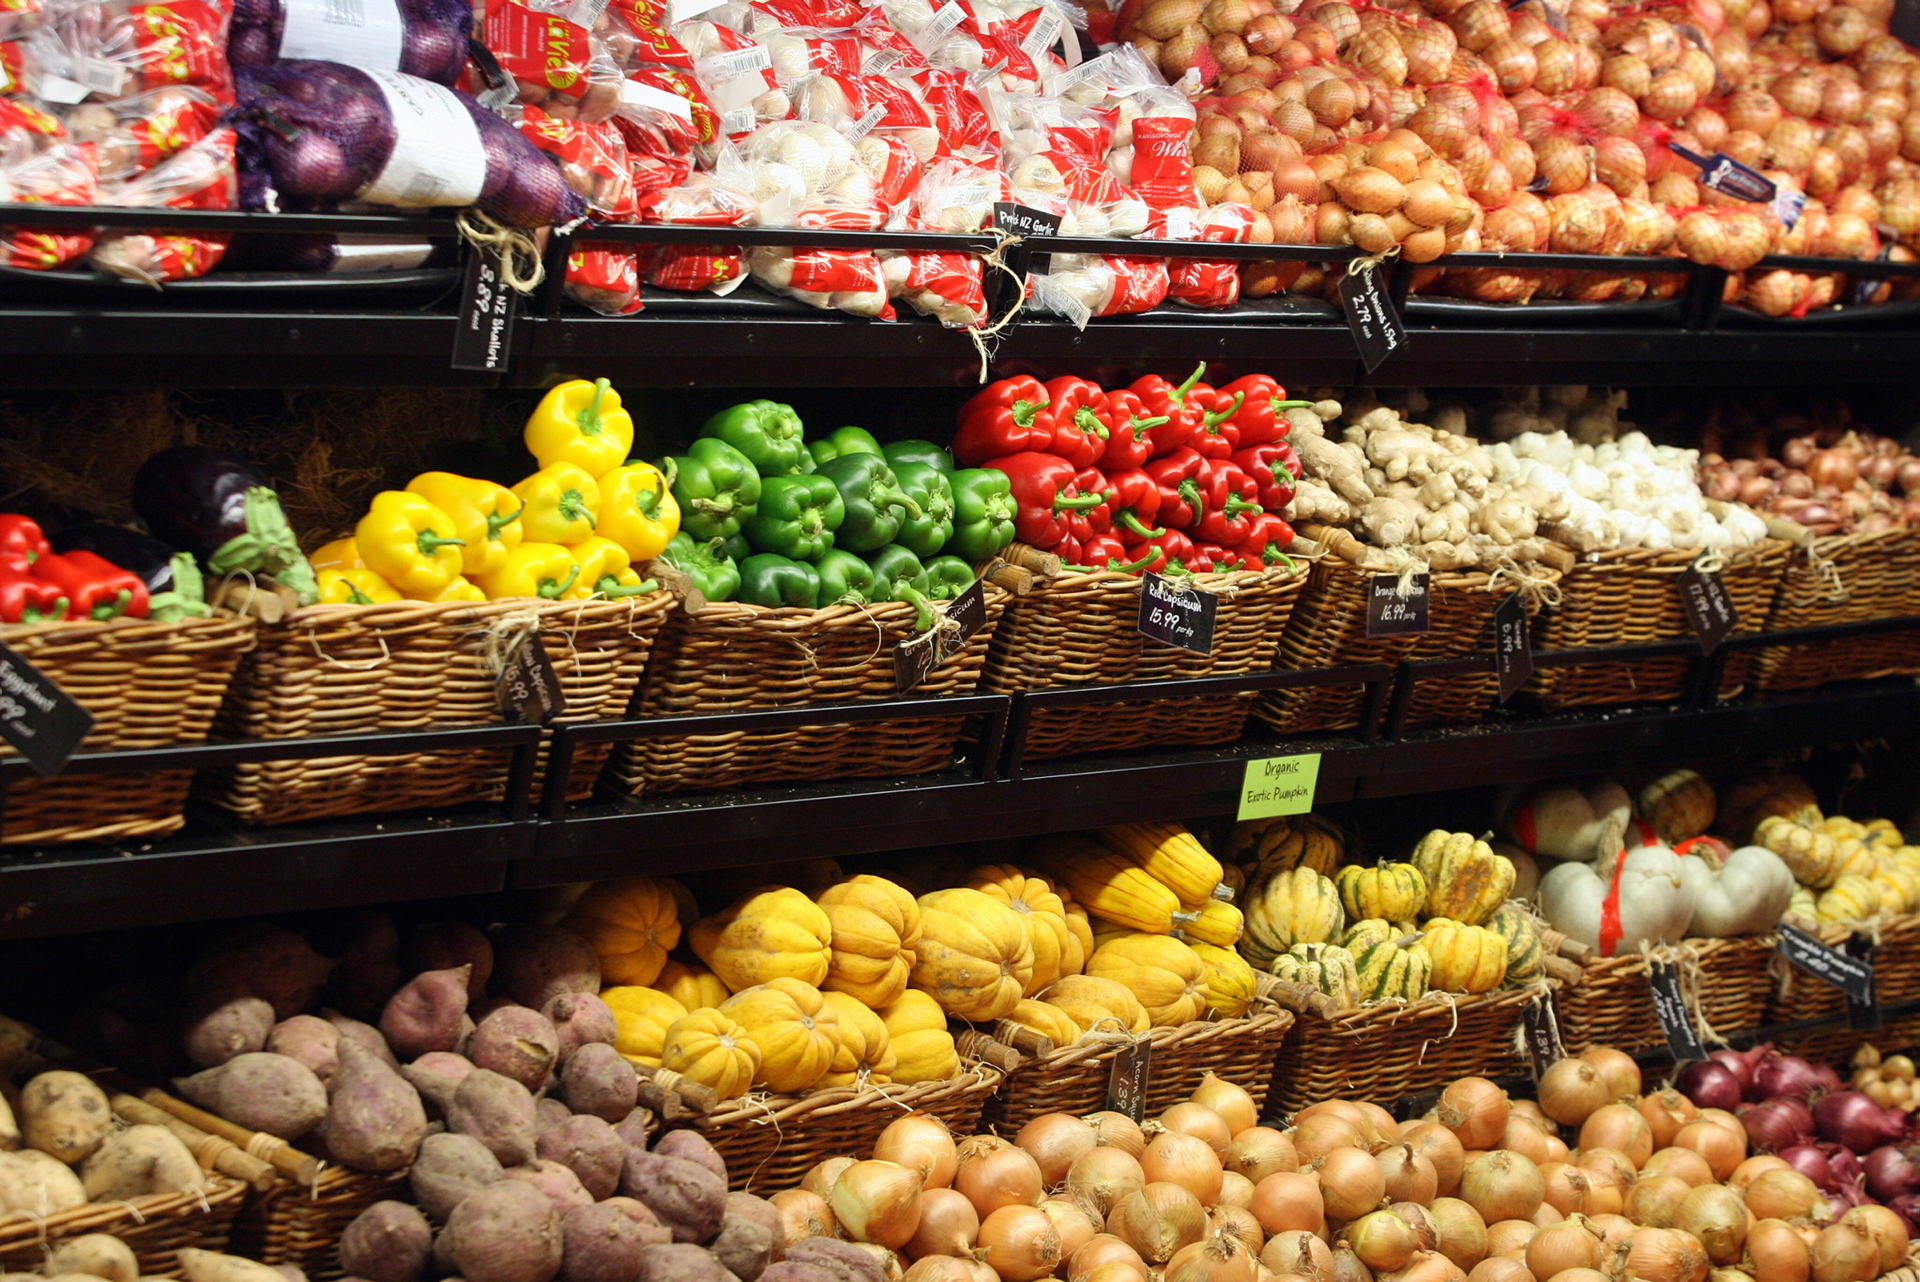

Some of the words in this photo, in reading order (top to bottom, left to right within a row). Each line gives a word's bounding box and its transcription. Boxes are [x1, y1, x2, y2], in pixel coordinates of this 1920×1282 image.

[547, 17, 567, 38] La
[546, 41, 571, 68] Vie
[1019, 216, 1033, 229] NZ
[1032, 219, 1055, 236] Garlic
[493, 295, 507, 315] NZ
[1352, 295, 1372, 323] 2.79
[1370, 291, 1387, 324] Onions
[1382, 322, 1398, 350] 1.5kg
[485, 318, 505, 368] Shallots
[1149, 583, 1163, 600] Red
[1163, 591, 1202, 613] Capsicum
[1149, 607, 1180, 630] 15.99
[1381, 604, 1405, 620] 16.99
[1264, 759, 1300, 780] Organic
[1247, 790, 1271, 803] Exotic
[1273, 785, 1308, 803] Pumpkin
[1535, 1029, 1550, 1055] 1.39
[1133, 1061, 1144, 1093] Acorn
[1116, 1077, 1129, 1109] 1.39
